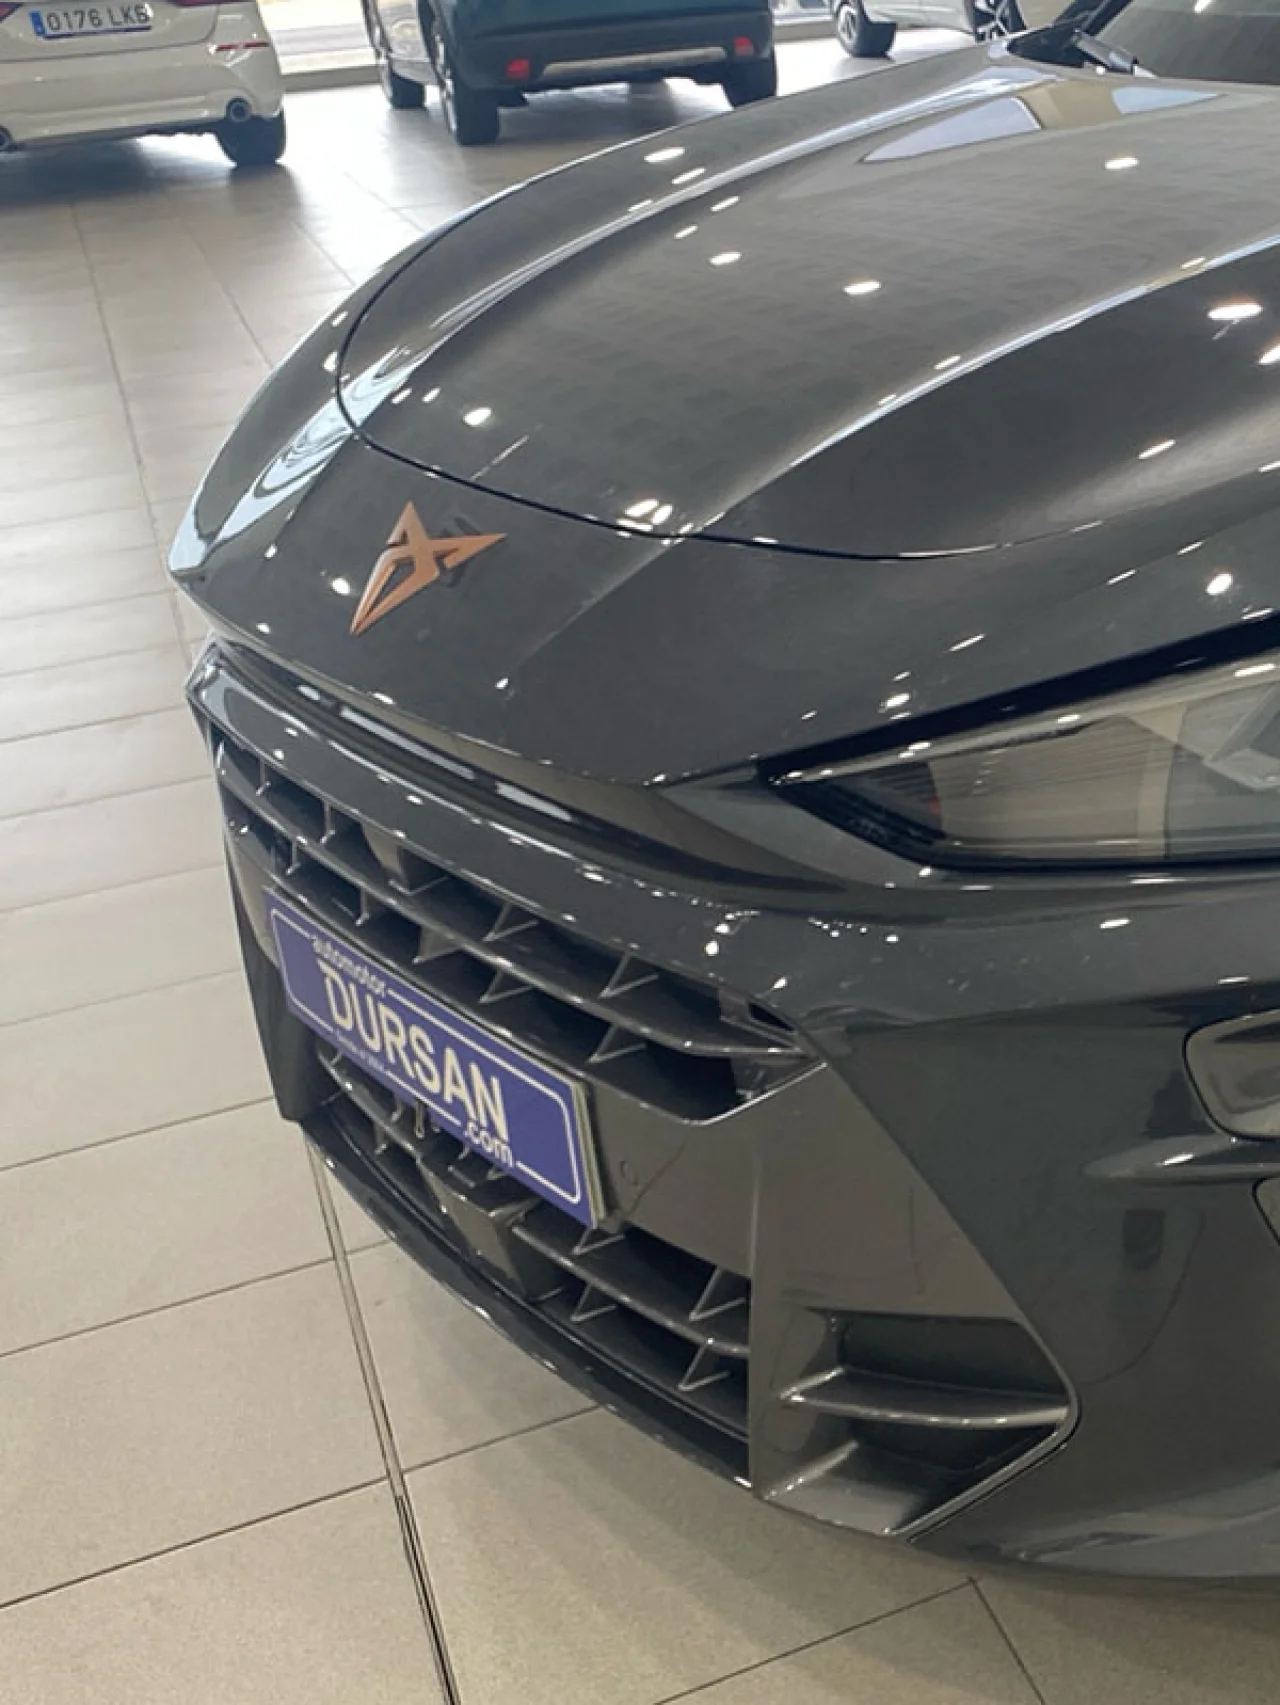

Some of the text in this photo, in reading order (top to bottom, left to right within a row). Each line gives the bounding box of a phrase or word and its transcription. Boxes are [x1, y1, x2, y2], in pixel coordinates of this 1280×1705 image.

[46, 8, 103, 31] 0176
[313, 937, 387, 998] automotor
[316, 958, 509, 1142] DURSAN
[462, 1120, 515, 1168] .com
